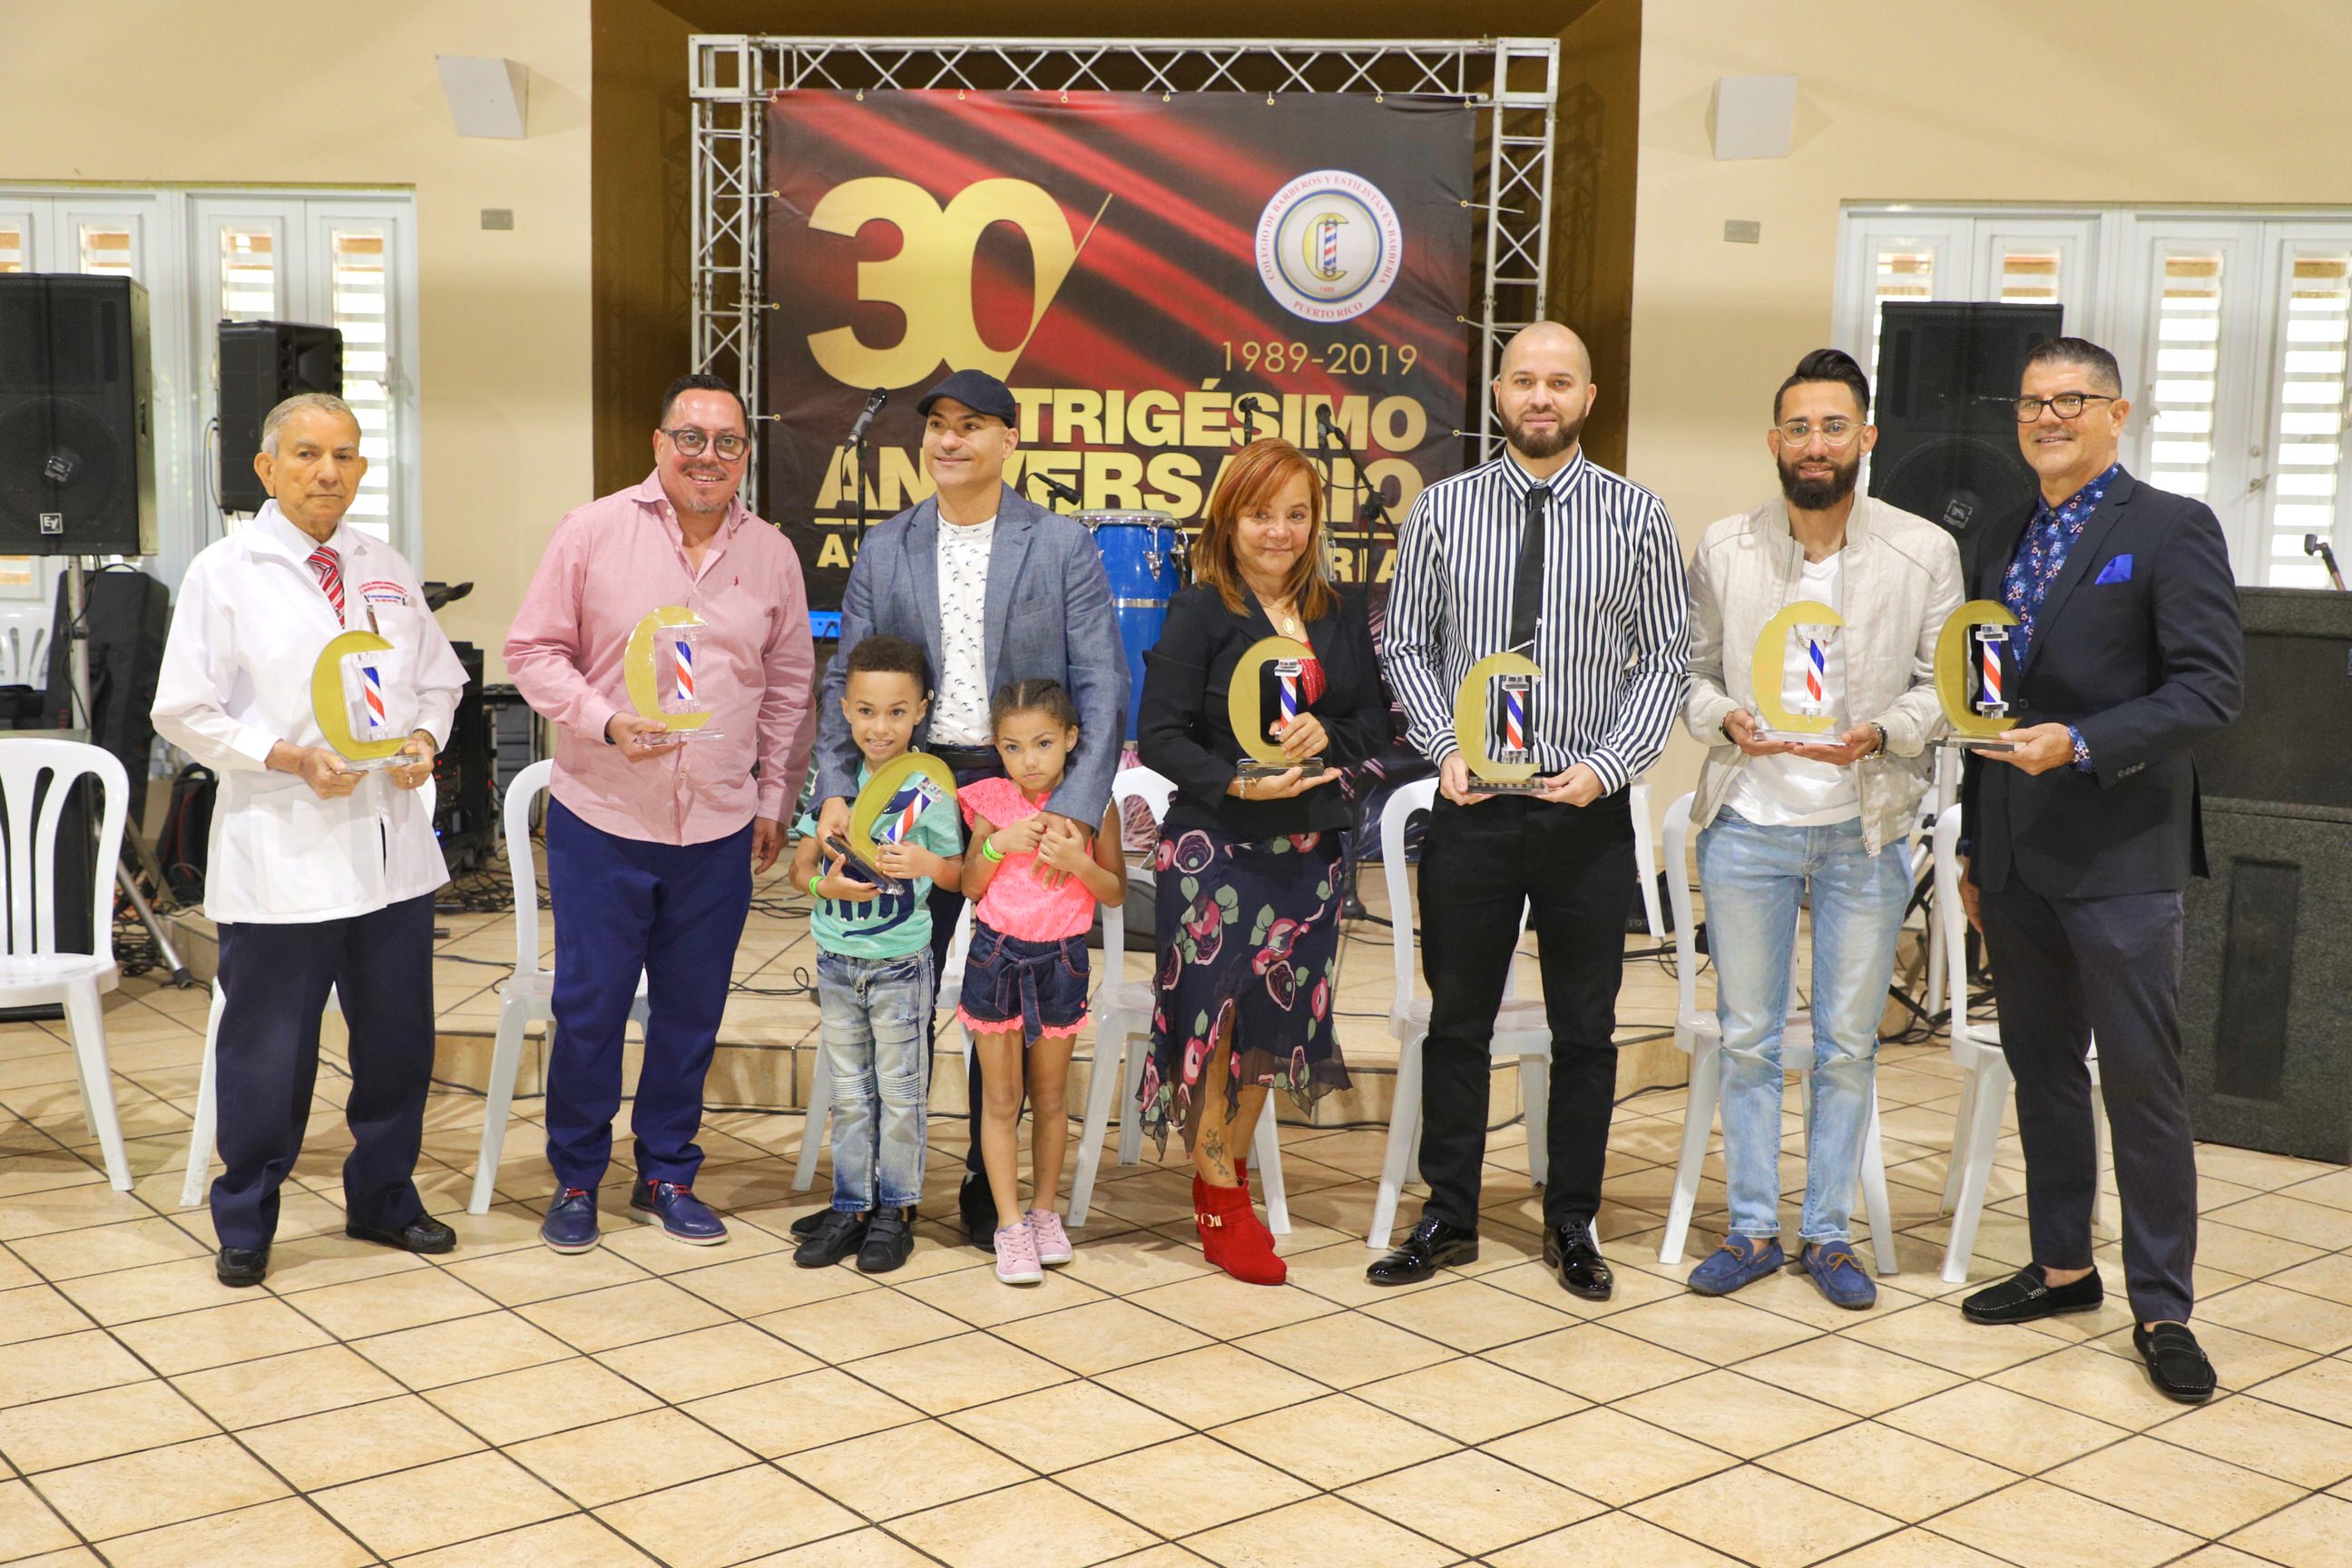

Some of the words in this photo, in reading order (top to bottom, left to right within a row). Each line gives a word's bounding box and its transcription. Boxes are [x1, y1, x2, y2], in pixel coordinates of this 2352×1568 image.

[1264, 214, 1275, 228] DE
[1272, 176, 1322, 212] BARBEROS
[807, 177, 1112, 390] 30
[1293, 300, 1335, 318] PUERTO
[1337, 301, 1363, 317] RICO
[1222, 341, 1417, 376] 1989-2019
[1007, 378, 1427, 452] TRIGÉSIMO
